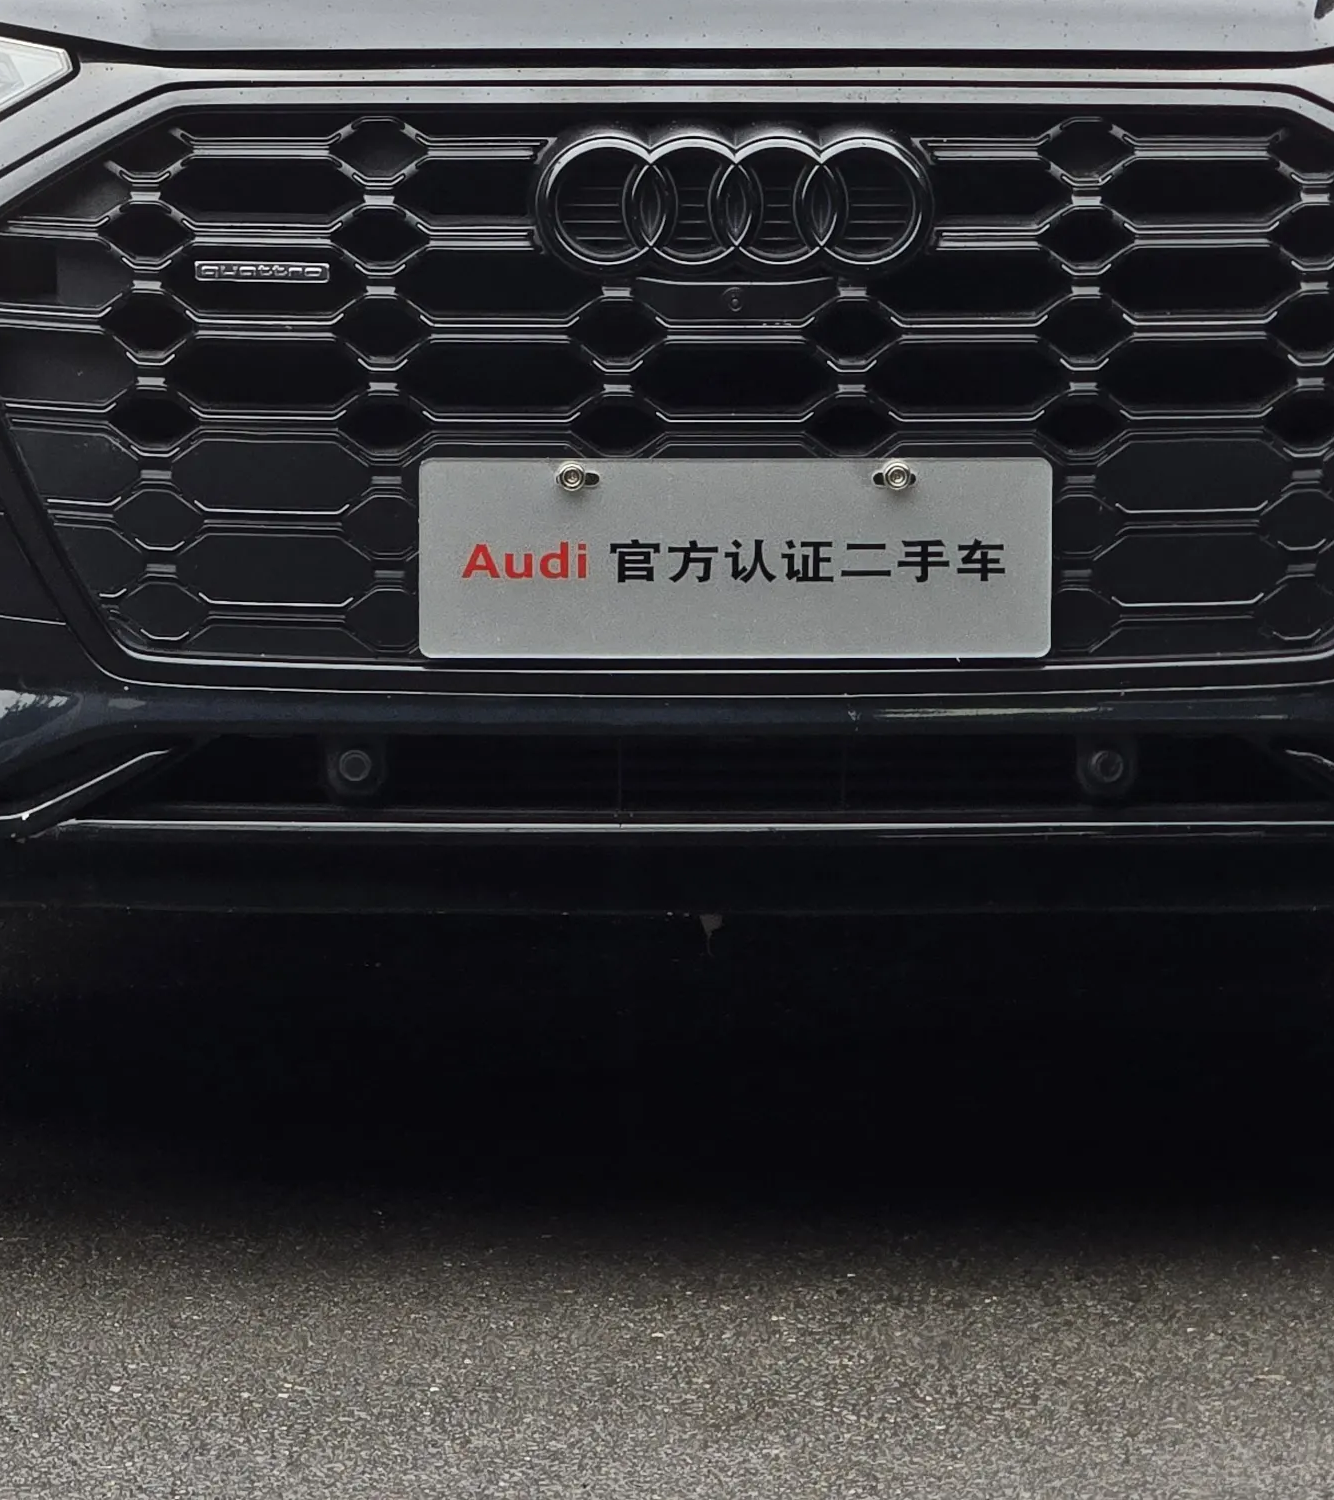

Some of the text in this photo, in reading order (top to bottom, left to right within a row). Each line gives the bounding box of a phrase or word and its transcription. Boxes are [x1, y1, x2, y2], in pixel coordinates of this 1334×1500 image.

[462, 538, 1006, 584] Audi 官方认证二手车
